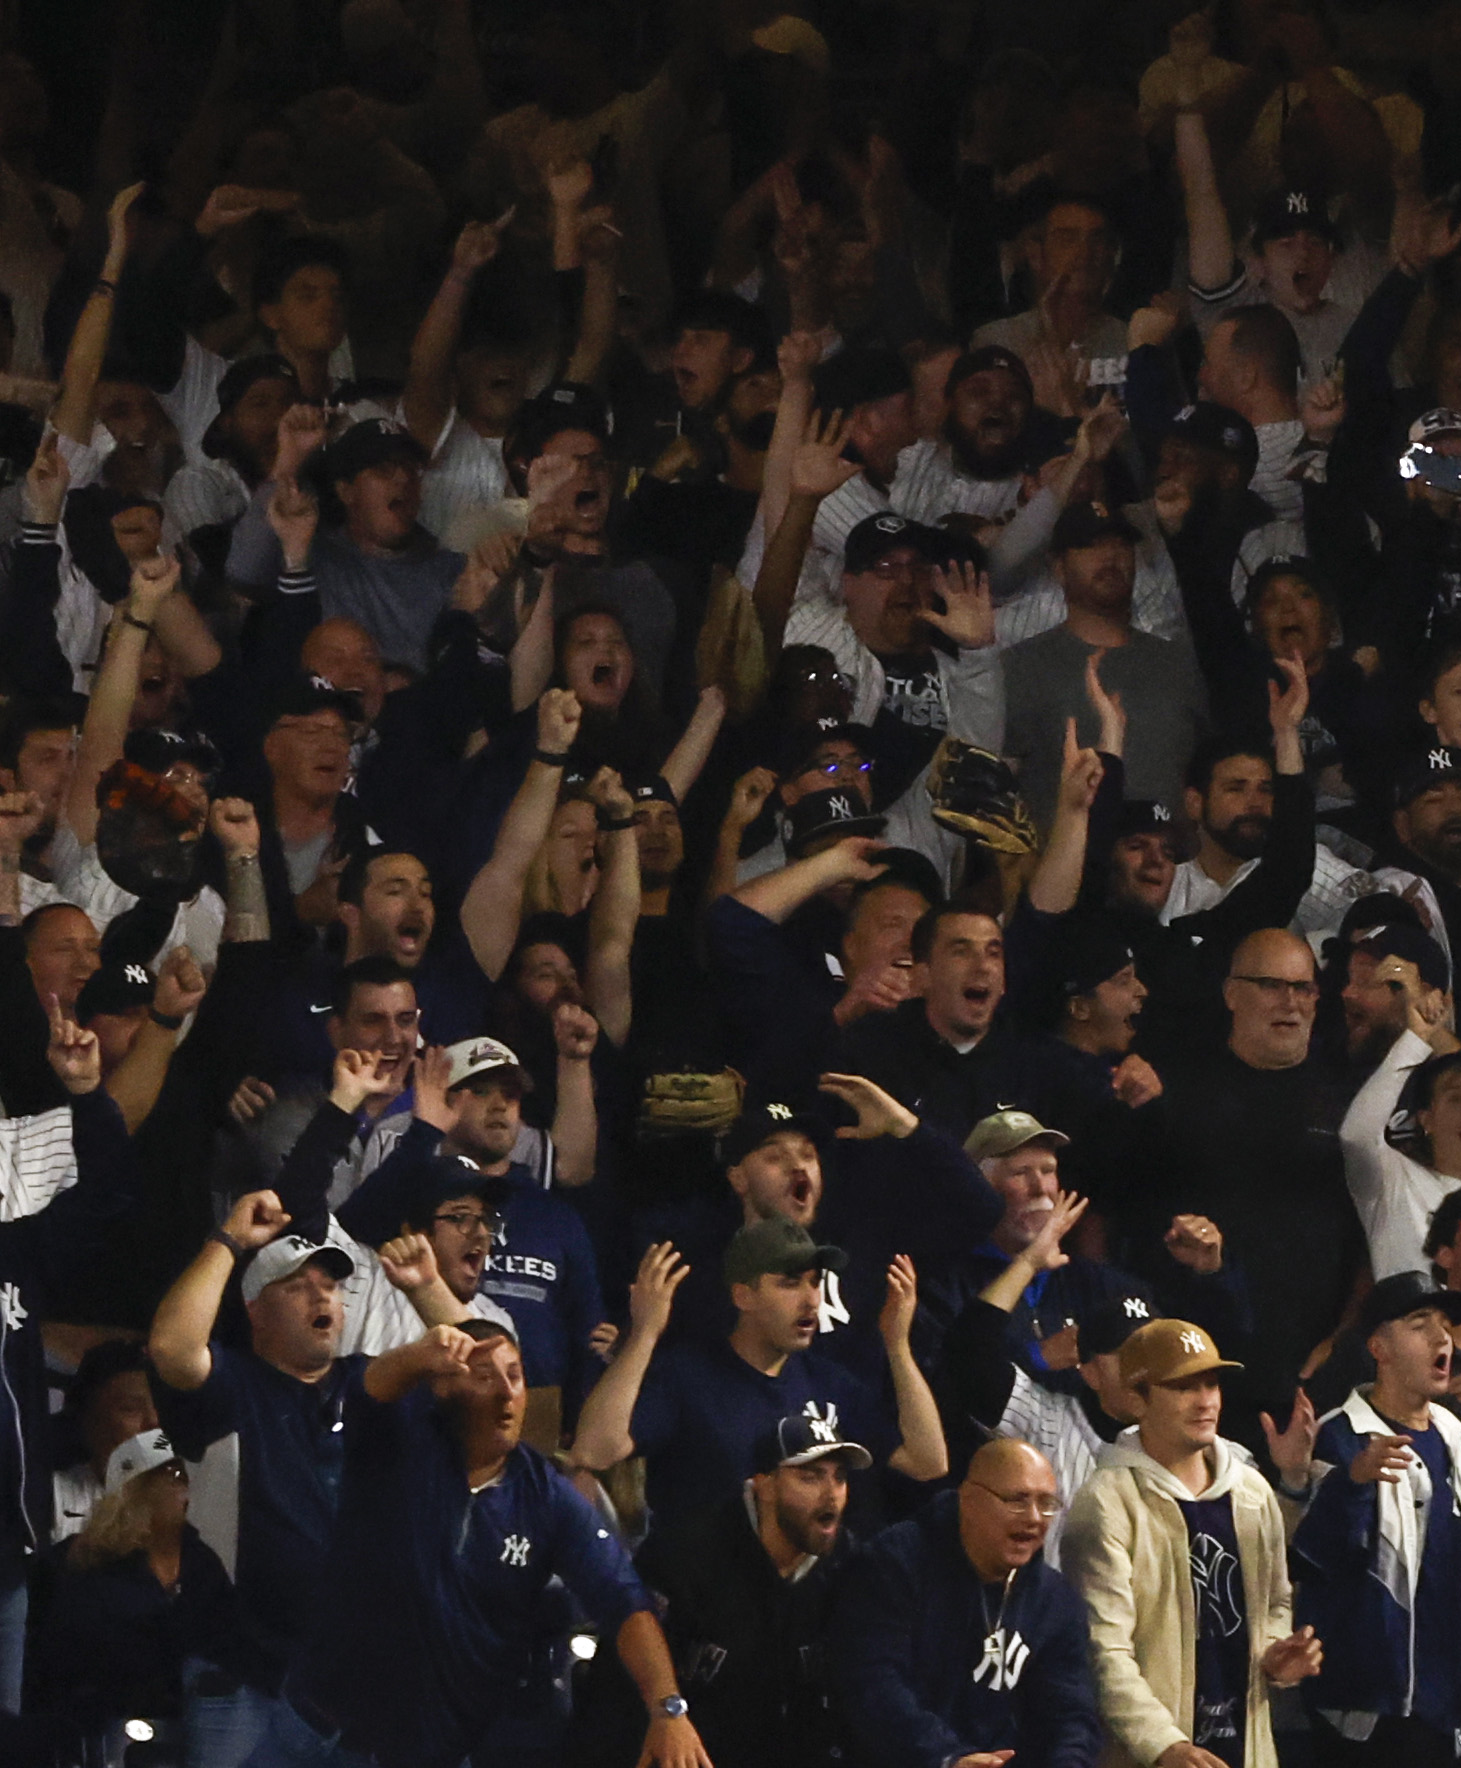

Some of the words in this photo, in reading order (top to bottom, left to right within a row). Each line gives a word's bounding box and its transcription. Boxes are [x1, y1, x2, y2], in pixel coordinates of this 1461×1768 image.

[1286, 191, 1308, 215] NY
[1428, 748, 1452, 769] NY
[828, 795, 853, 822] NY
[123, 962, 149, 986] NY
[766, 1102, 794, 1122] NY
[1123, 1296, 1149, 1320] NY
[1180, 1330, 1207, 1353] NY
[809, 1419, 839, 1443] NY
[499, 1534, 532, 1568] NY
[970, 1628, 1032, 1692] NY
